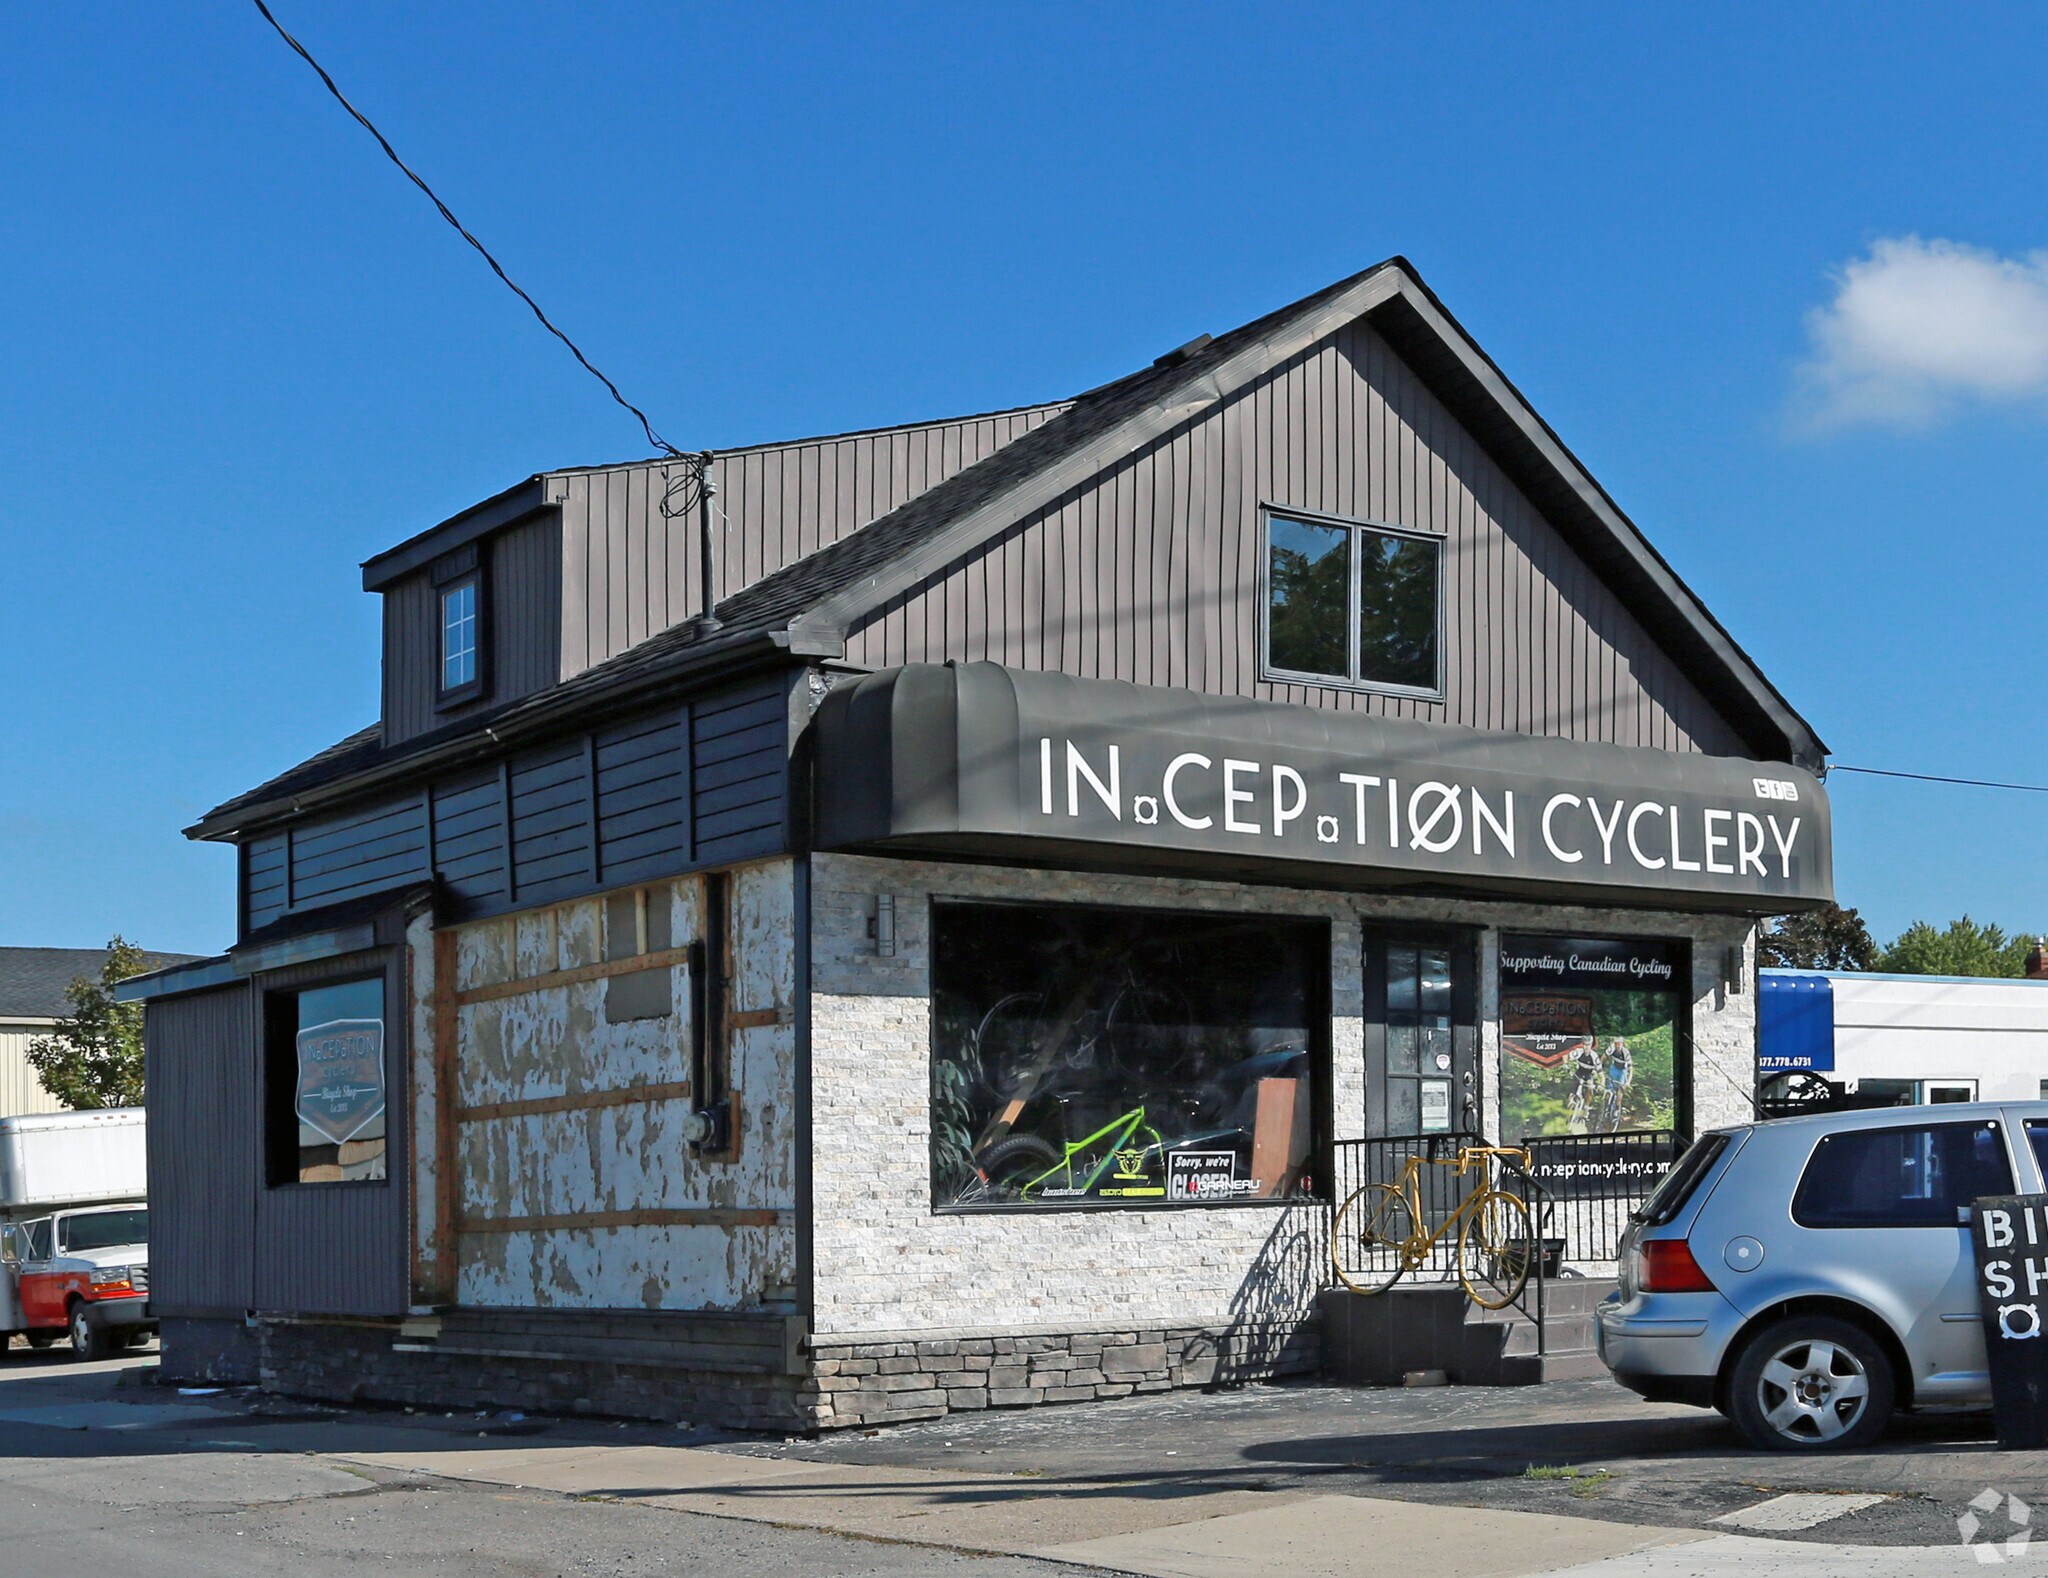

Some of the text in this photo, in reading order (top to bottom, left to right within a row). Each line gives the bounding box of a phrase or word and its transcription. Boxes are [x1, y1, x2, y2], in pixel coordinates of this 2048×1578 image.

[1542, 793, 1800, 878] CYCLERY
[1500, 951, 1673, 980] Supporting Canadian Cycling
[1205, 1156, 1230, 1167] we're
[1172, 1173, 1231, 1199] CLOSED
[1198, 1180, 1260, 1191] GARNEAU
[1982, 1205, 2048, 1248] BI
